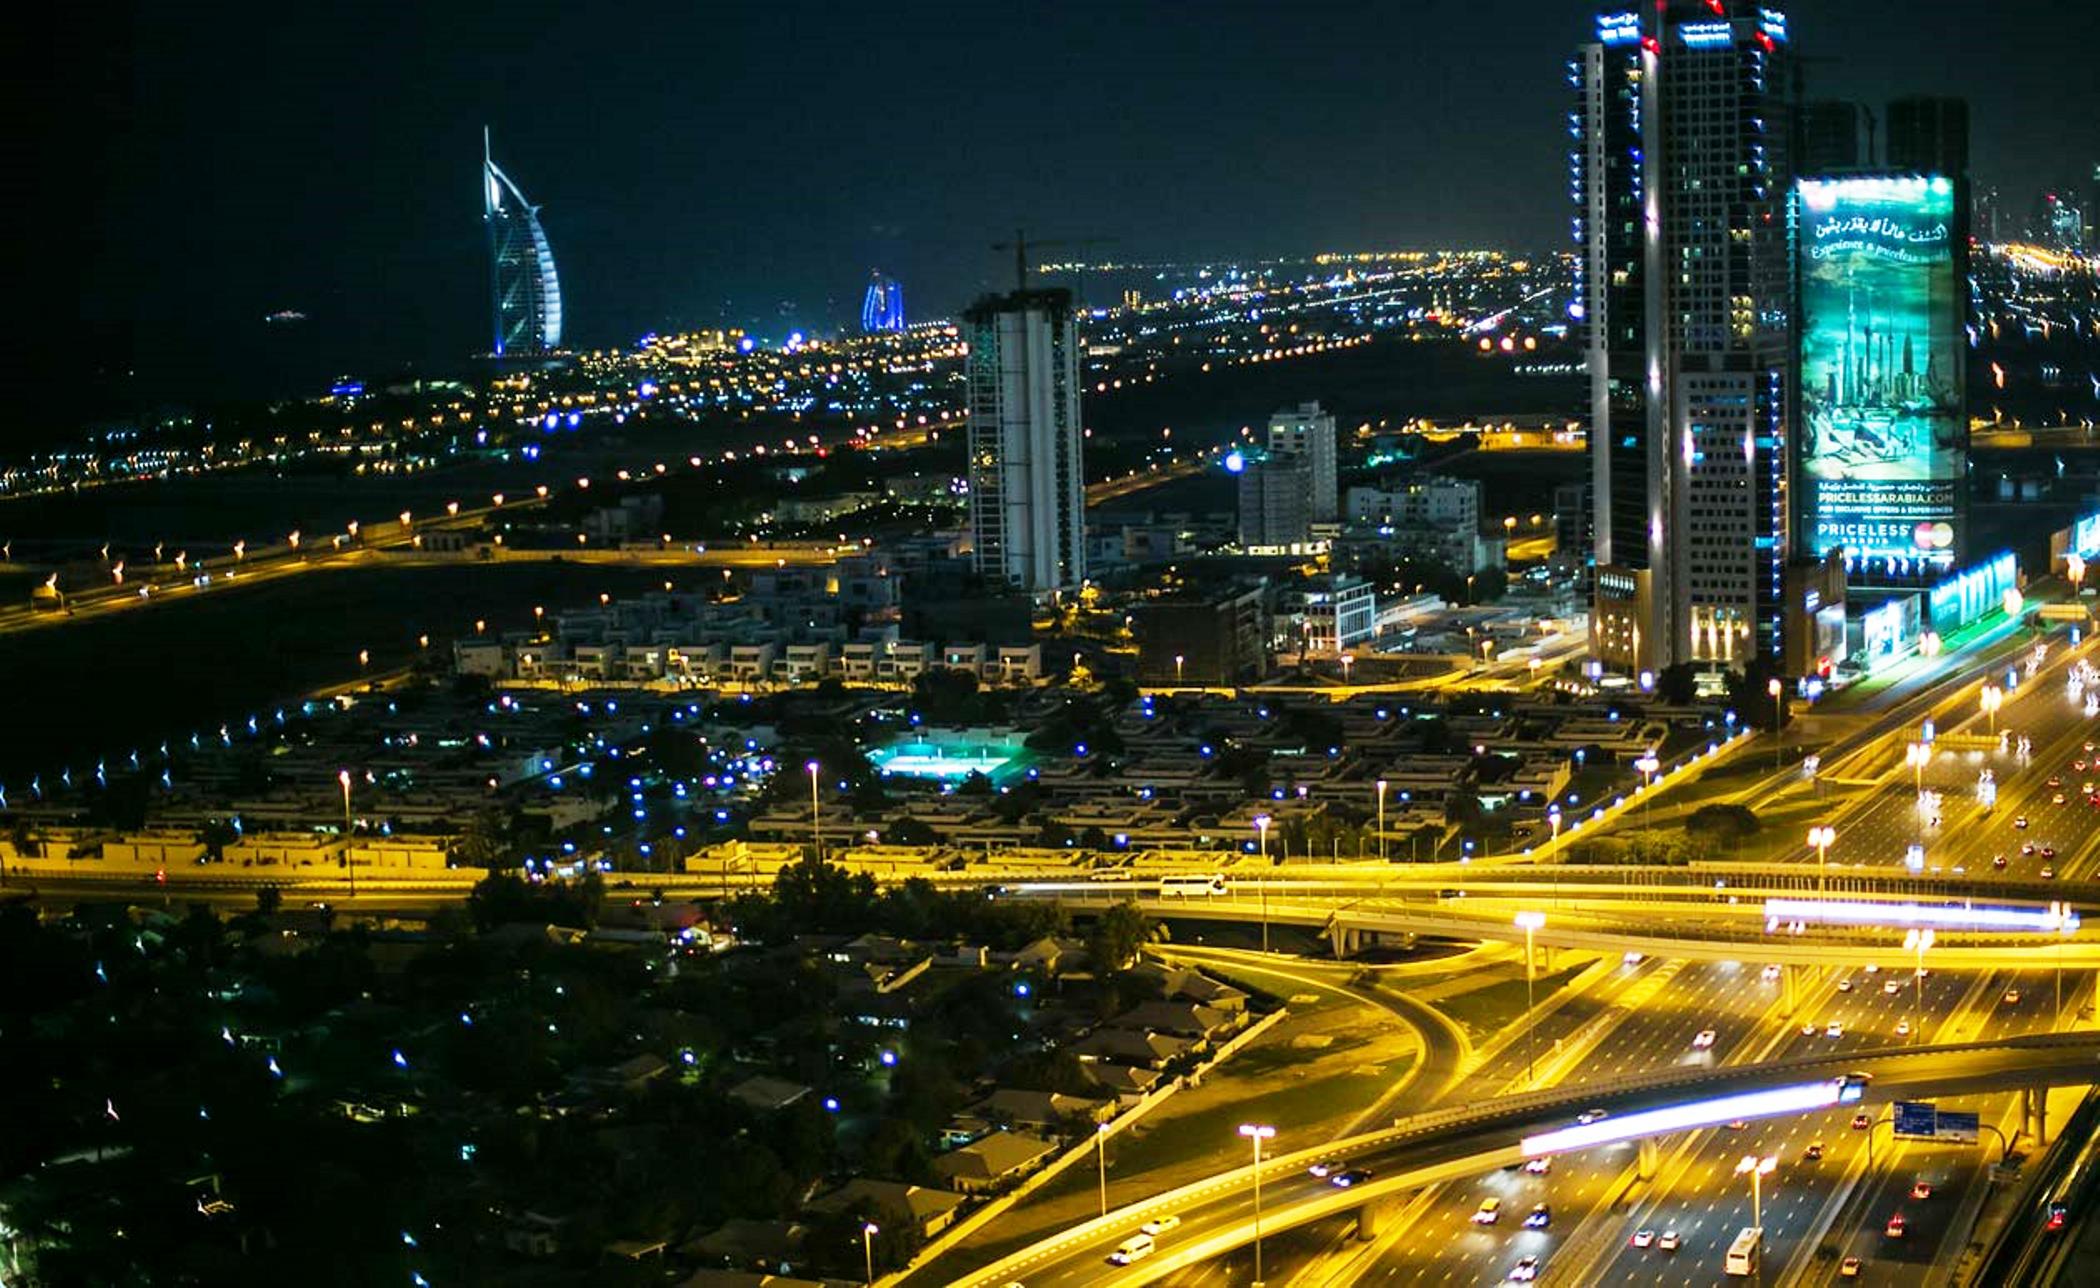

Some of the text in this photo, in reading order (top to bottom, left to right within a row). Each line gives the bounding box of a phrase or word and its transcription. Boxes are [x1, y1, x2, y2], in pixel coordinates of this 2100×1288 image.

[1811, 239, 1864, 259] Experience
[1818, 493, 1953, 503] PRICELESSARABIA.COM
[1818, 524, 1909, 536] PRICELESS
